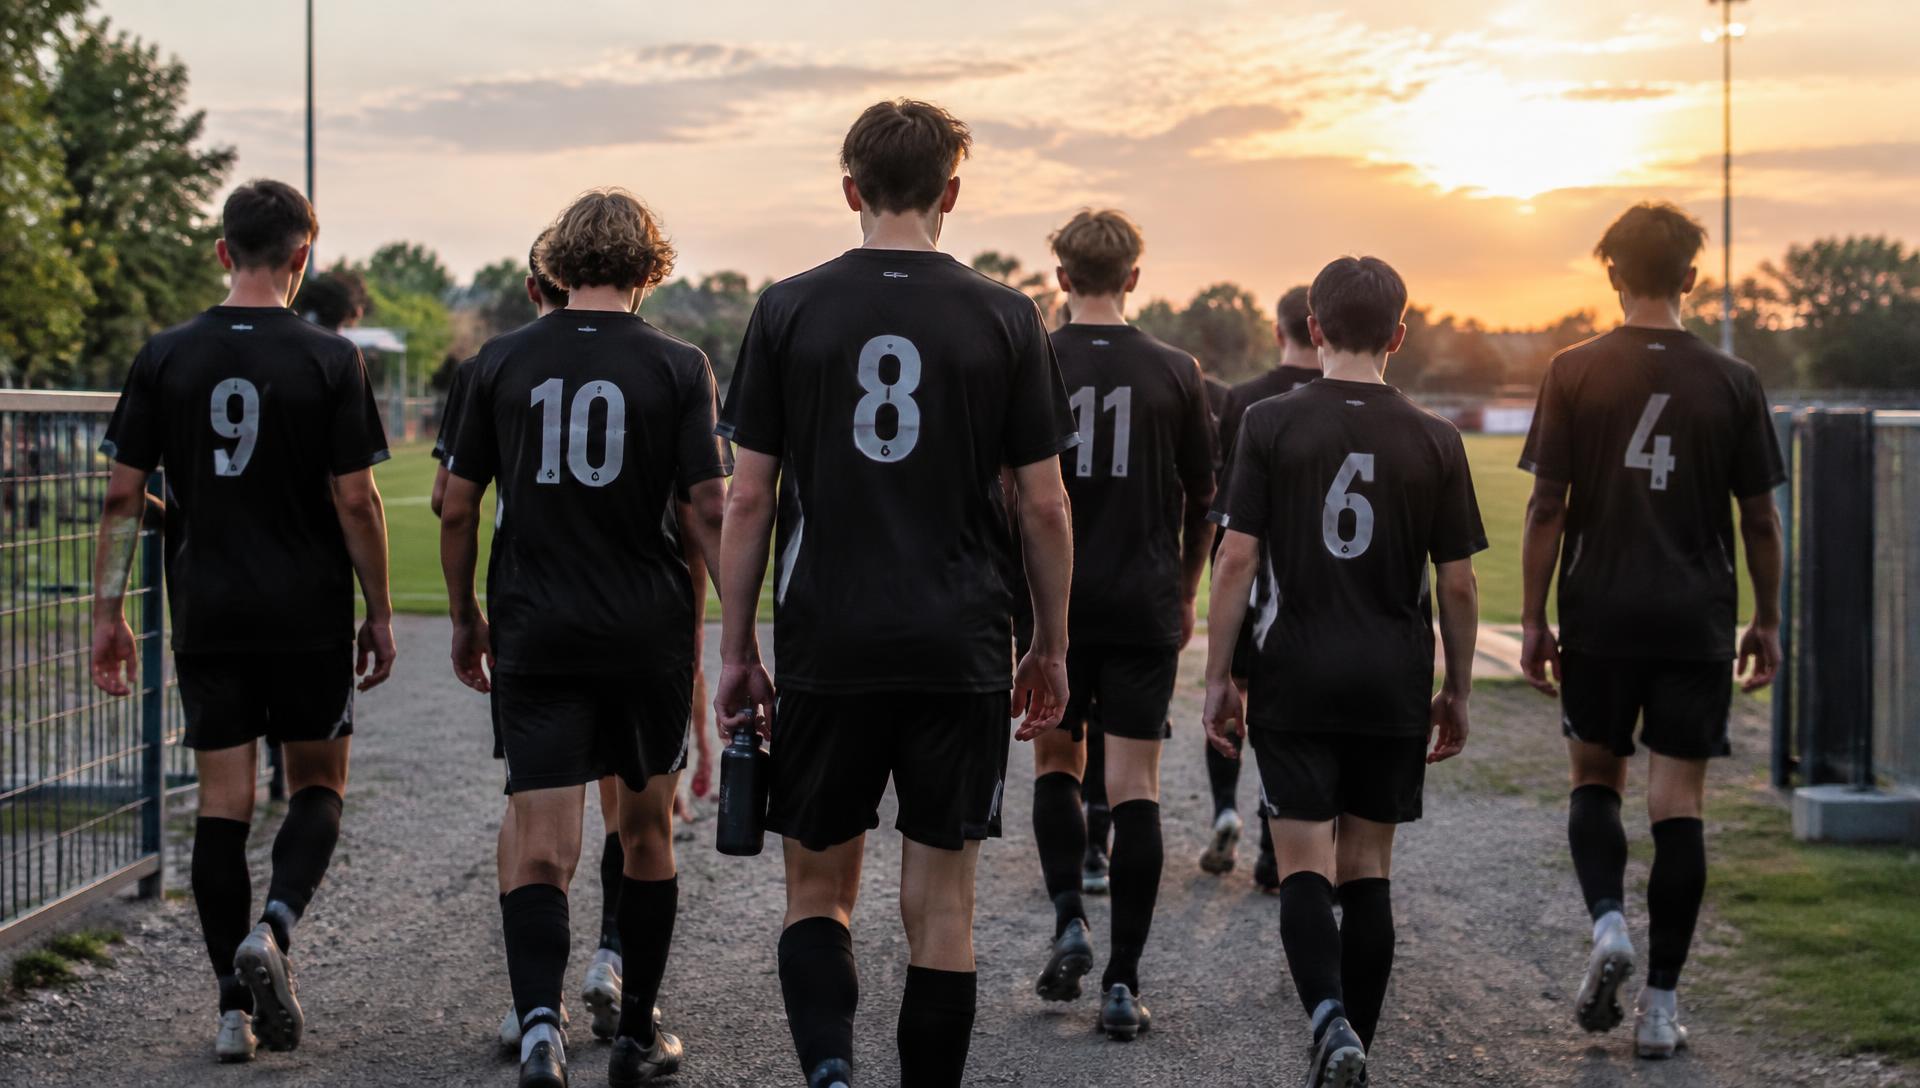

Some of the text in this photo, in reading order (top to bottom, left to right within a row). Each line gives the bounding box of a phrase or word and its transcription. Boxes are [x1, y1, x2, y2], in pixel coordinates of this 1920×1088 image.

[210, 377, 260, 476] 9
[530, 377, 626, 487] 10
[853, 334, 922, 463] 8
[1069, 386, 1132, 477] 11
[1624, 393, 1676, 491] 4
[1322, 452, 1375, 559] 6
